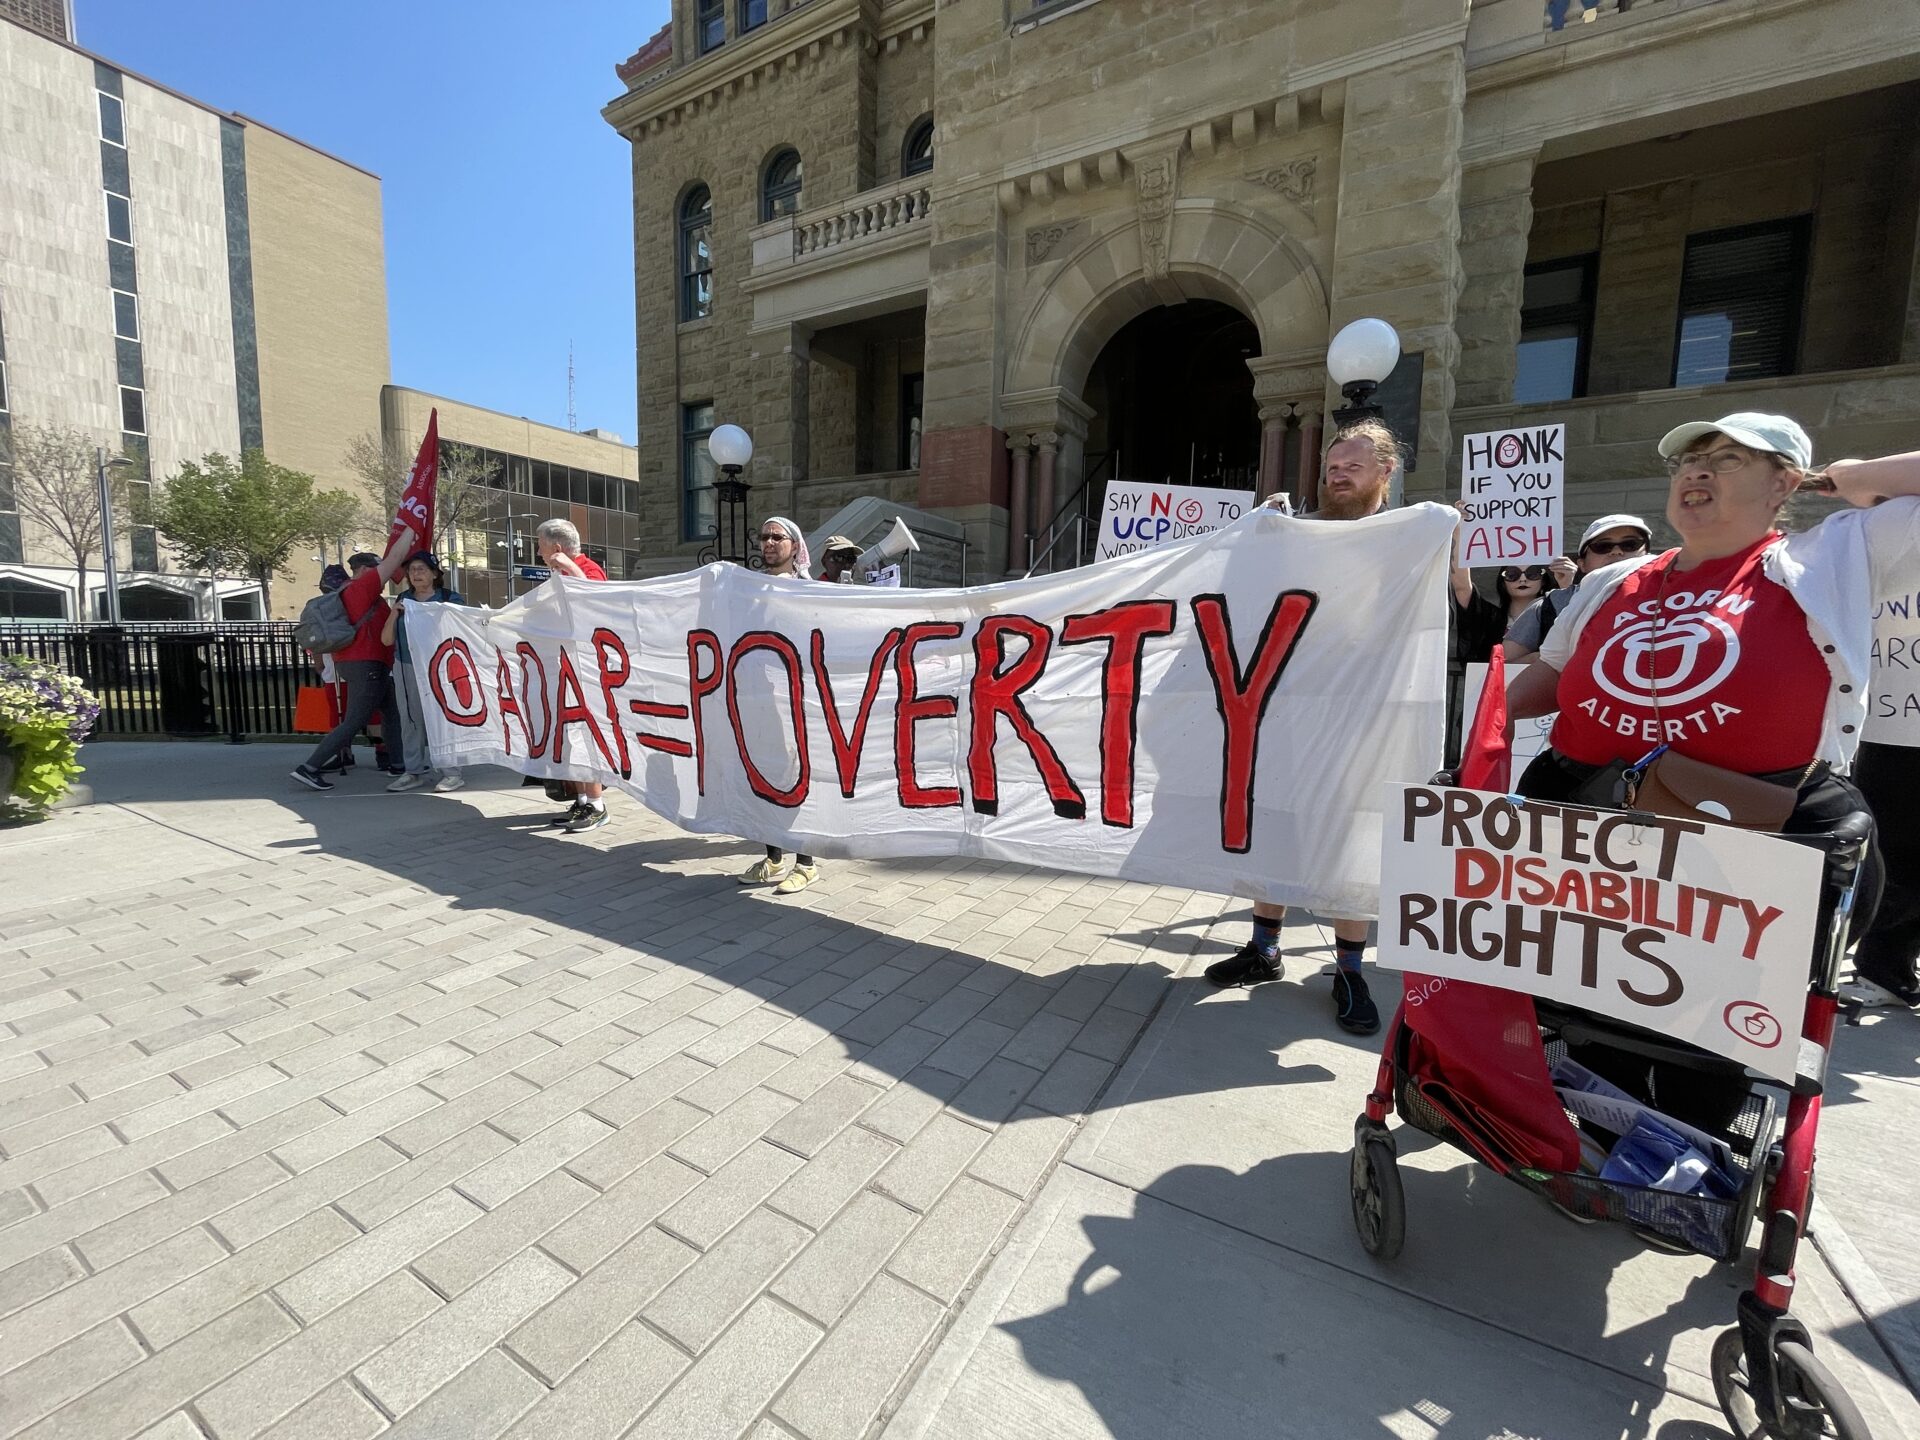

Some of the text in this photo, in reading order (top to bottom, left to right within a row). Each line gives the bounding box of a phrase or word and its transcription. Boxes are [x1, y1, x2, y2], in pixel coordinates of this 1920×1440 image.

[1468, 428, 1563, 471] HONK
[1470, 472, 1551, 494] IF YOU
[1109, 492, 1142, 513] SAY
[1218, 501, 1241, 520] TO
[1464, 496, 1557, 522] SUPPORT
[1113, 516, 1171, 541] UCP
[1466, 525, 1553, 560] AISH
[1613, 590, 1755, 629] ACORN
[1577, 697, 1742, 741] ALBERTA
[1403, 788, 1705, 881] PROTECT
[1454, 848, 1784, 960] DISABILITY
[1399, 893, 1684, 1007] RIGHTS
